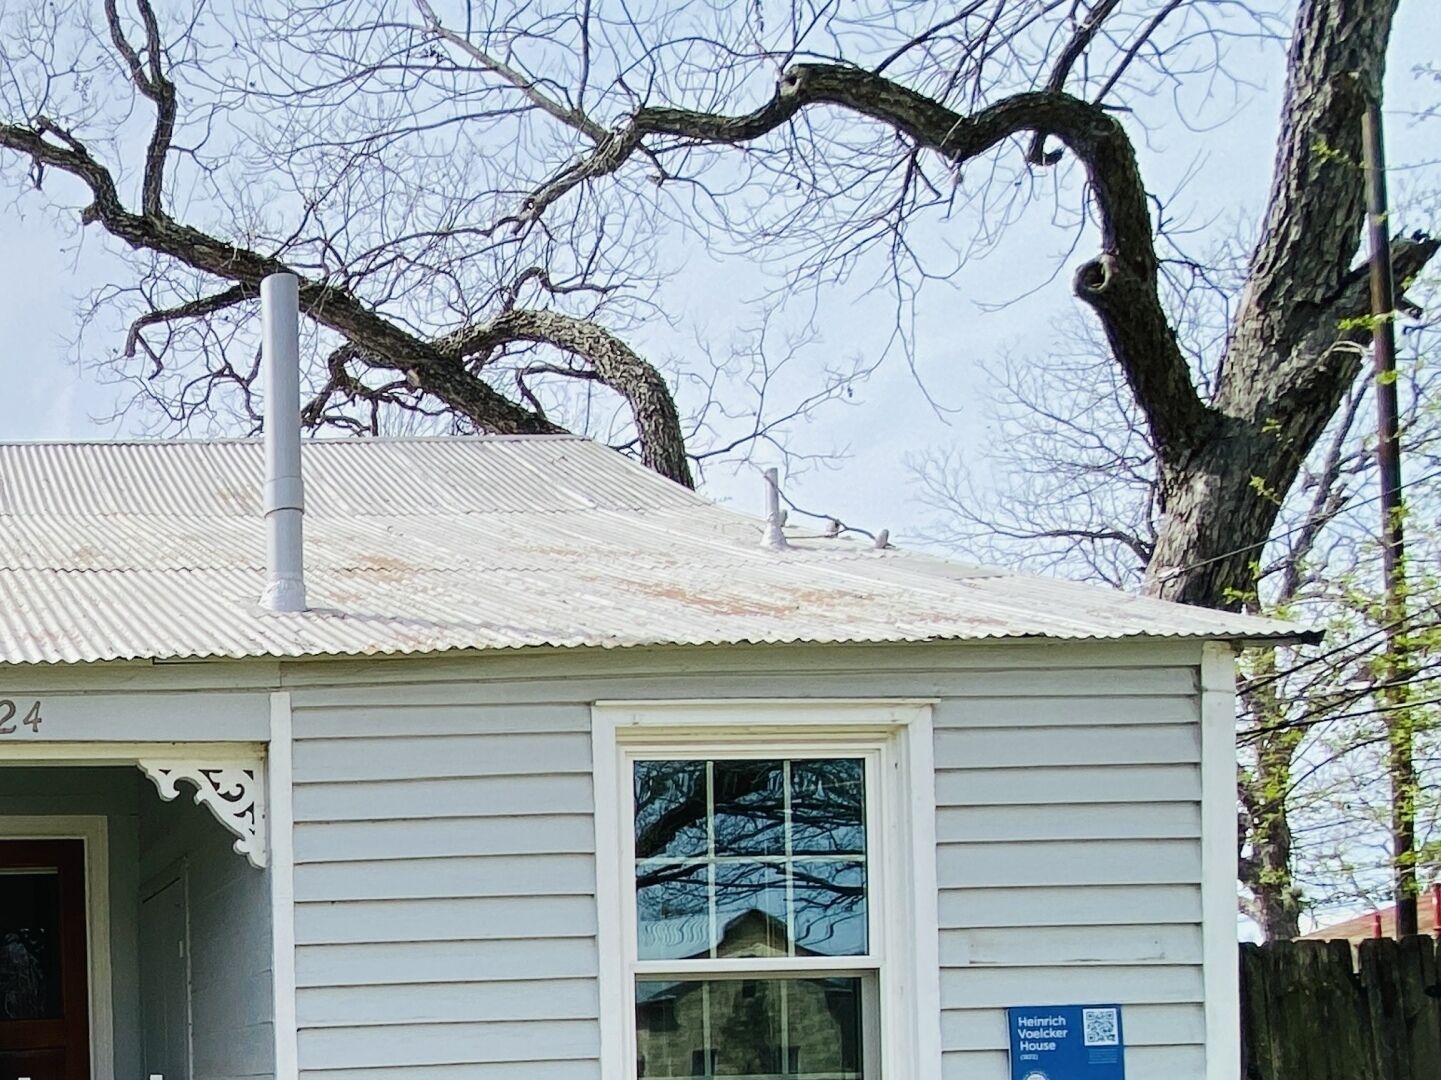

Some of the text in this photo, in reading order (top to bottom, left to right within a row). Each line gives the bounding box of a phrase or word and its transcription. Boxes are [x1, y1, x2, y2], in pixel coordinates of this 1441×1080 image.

[1017, 1015, 1066, 1027] Heinrich
[1017, 1028, 1068, 1039] Voelcker
[1019, 1040, 1057, 1051] House
